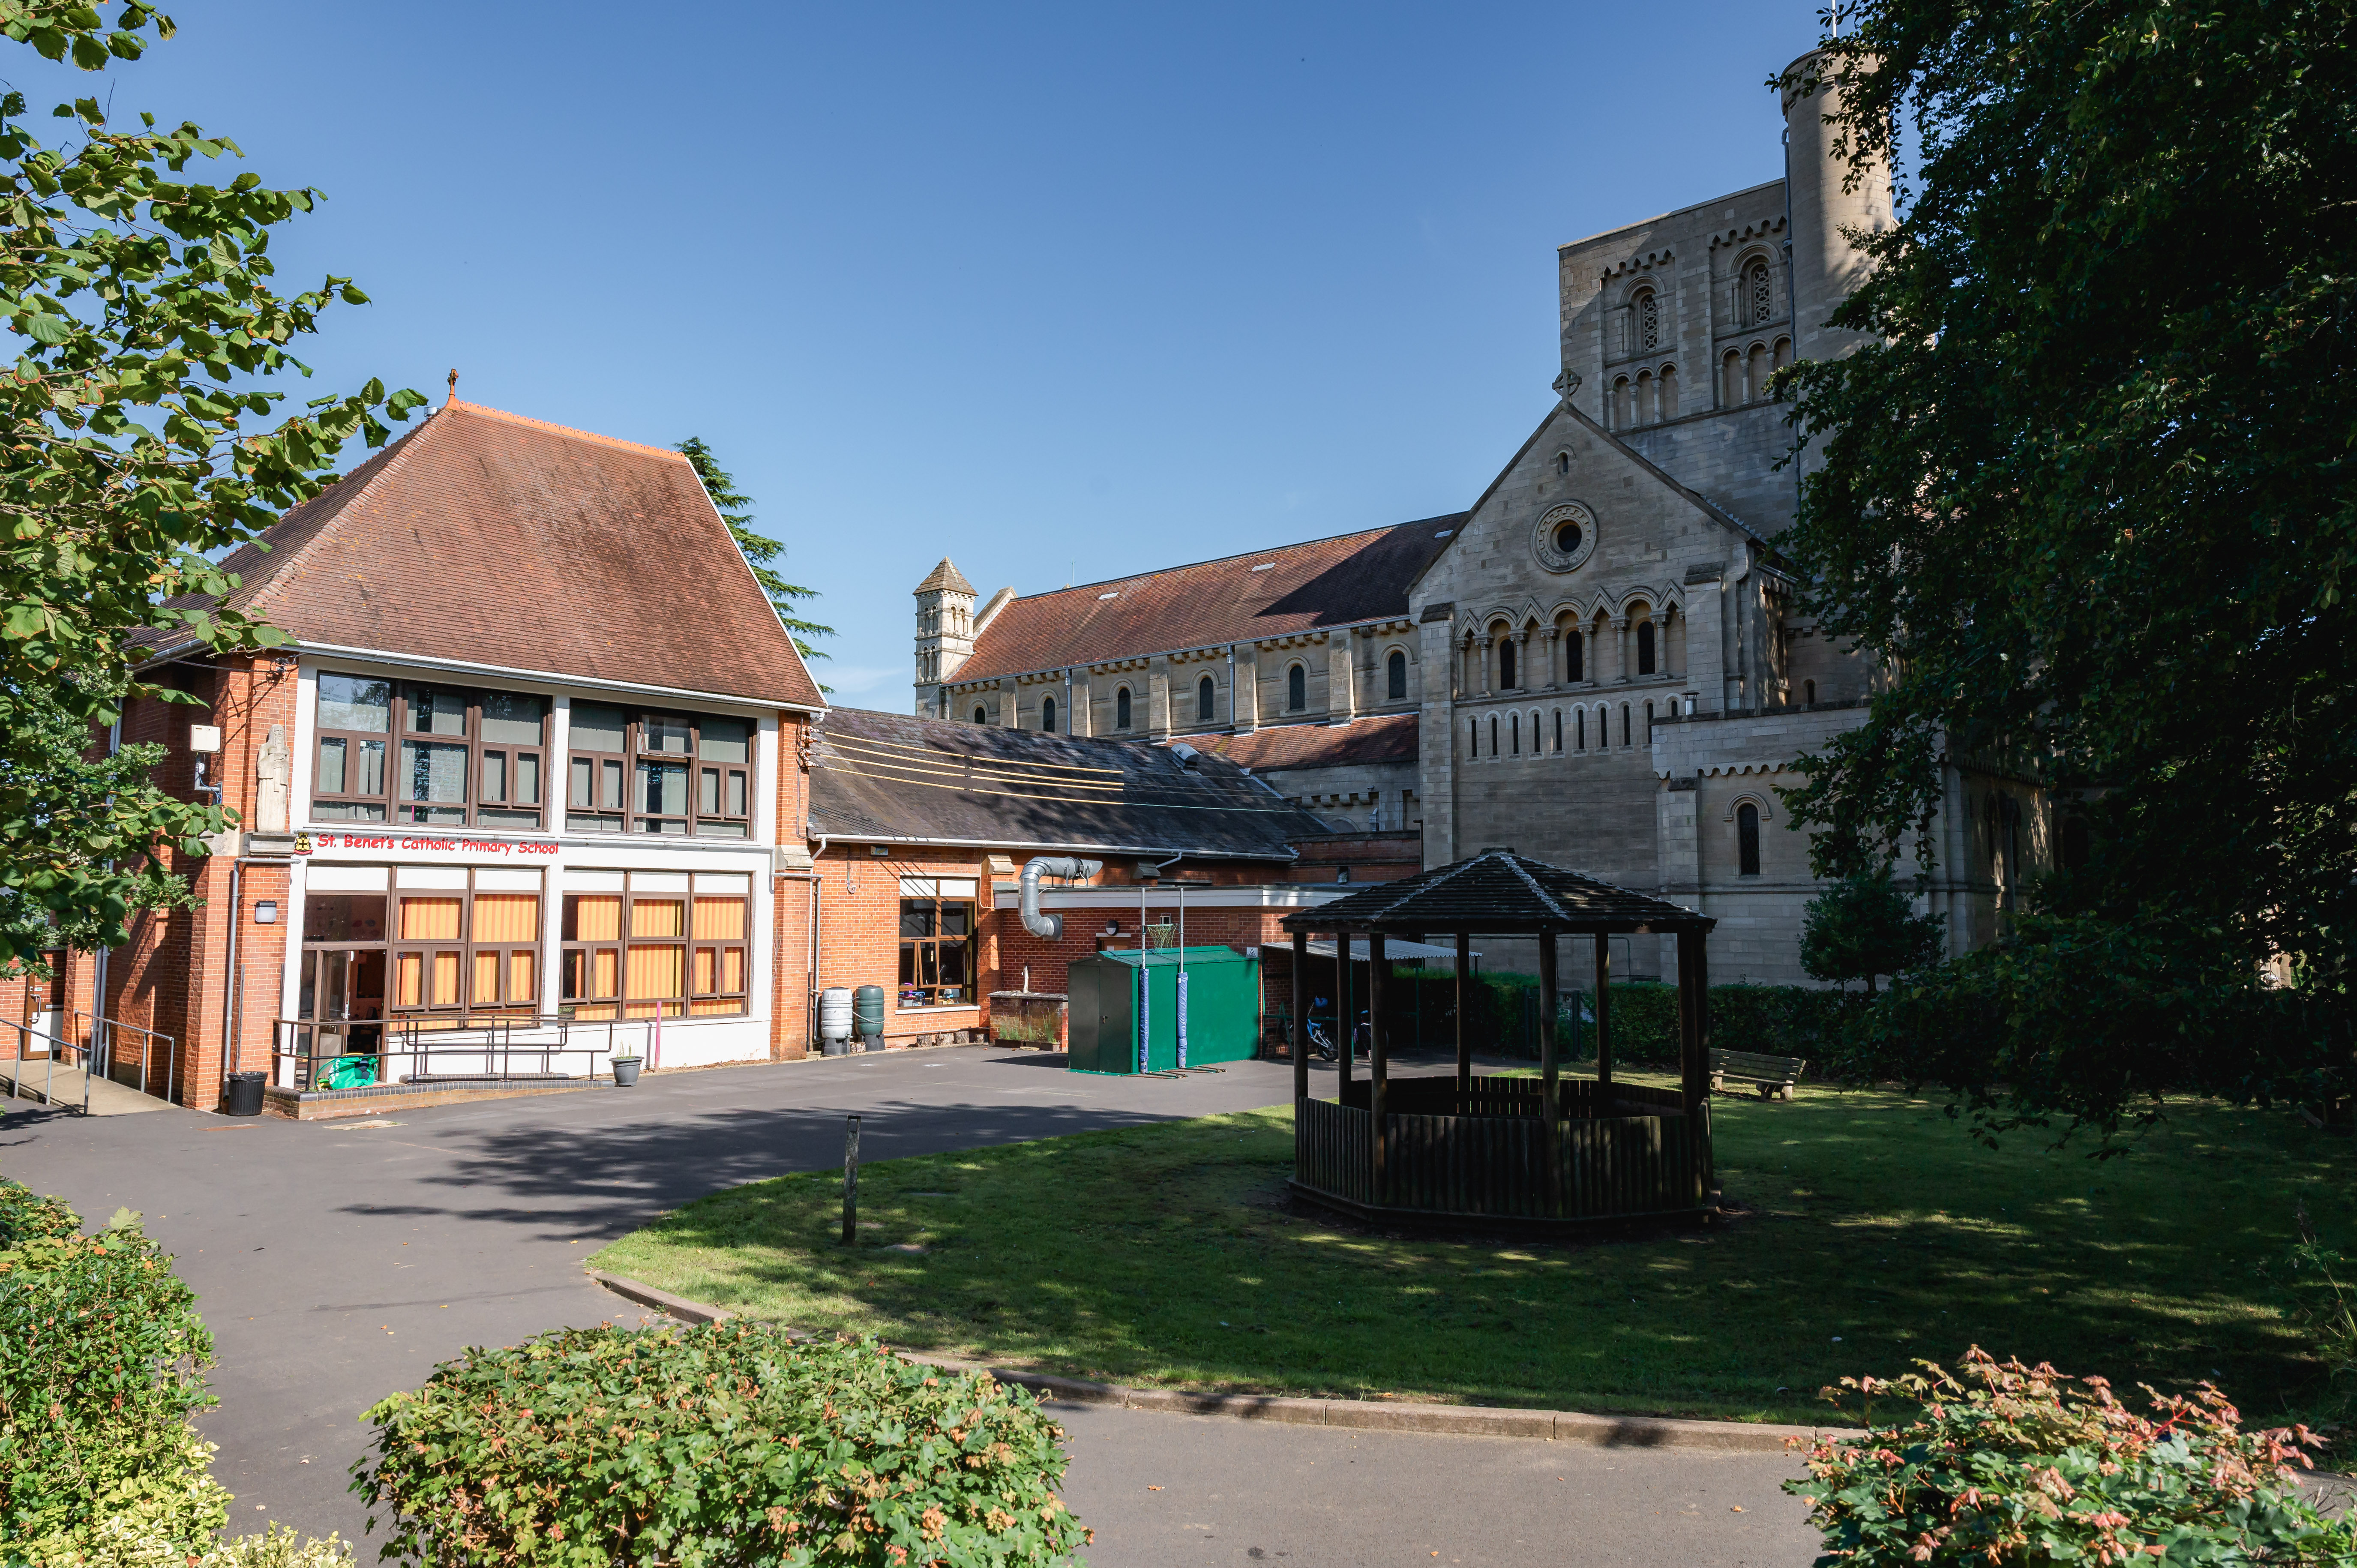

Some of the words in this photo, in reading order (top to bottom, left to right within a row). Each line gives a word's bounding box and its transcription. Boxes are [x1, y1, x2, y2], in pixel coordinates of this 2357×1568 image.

[317, 834, 336, 848] St.
[344, 834, 395, 849] Benet's
[402, 836, 456, 851] Catholic
[462, 839, 513, 856] Primary
[519, 841, 559, 854] School
